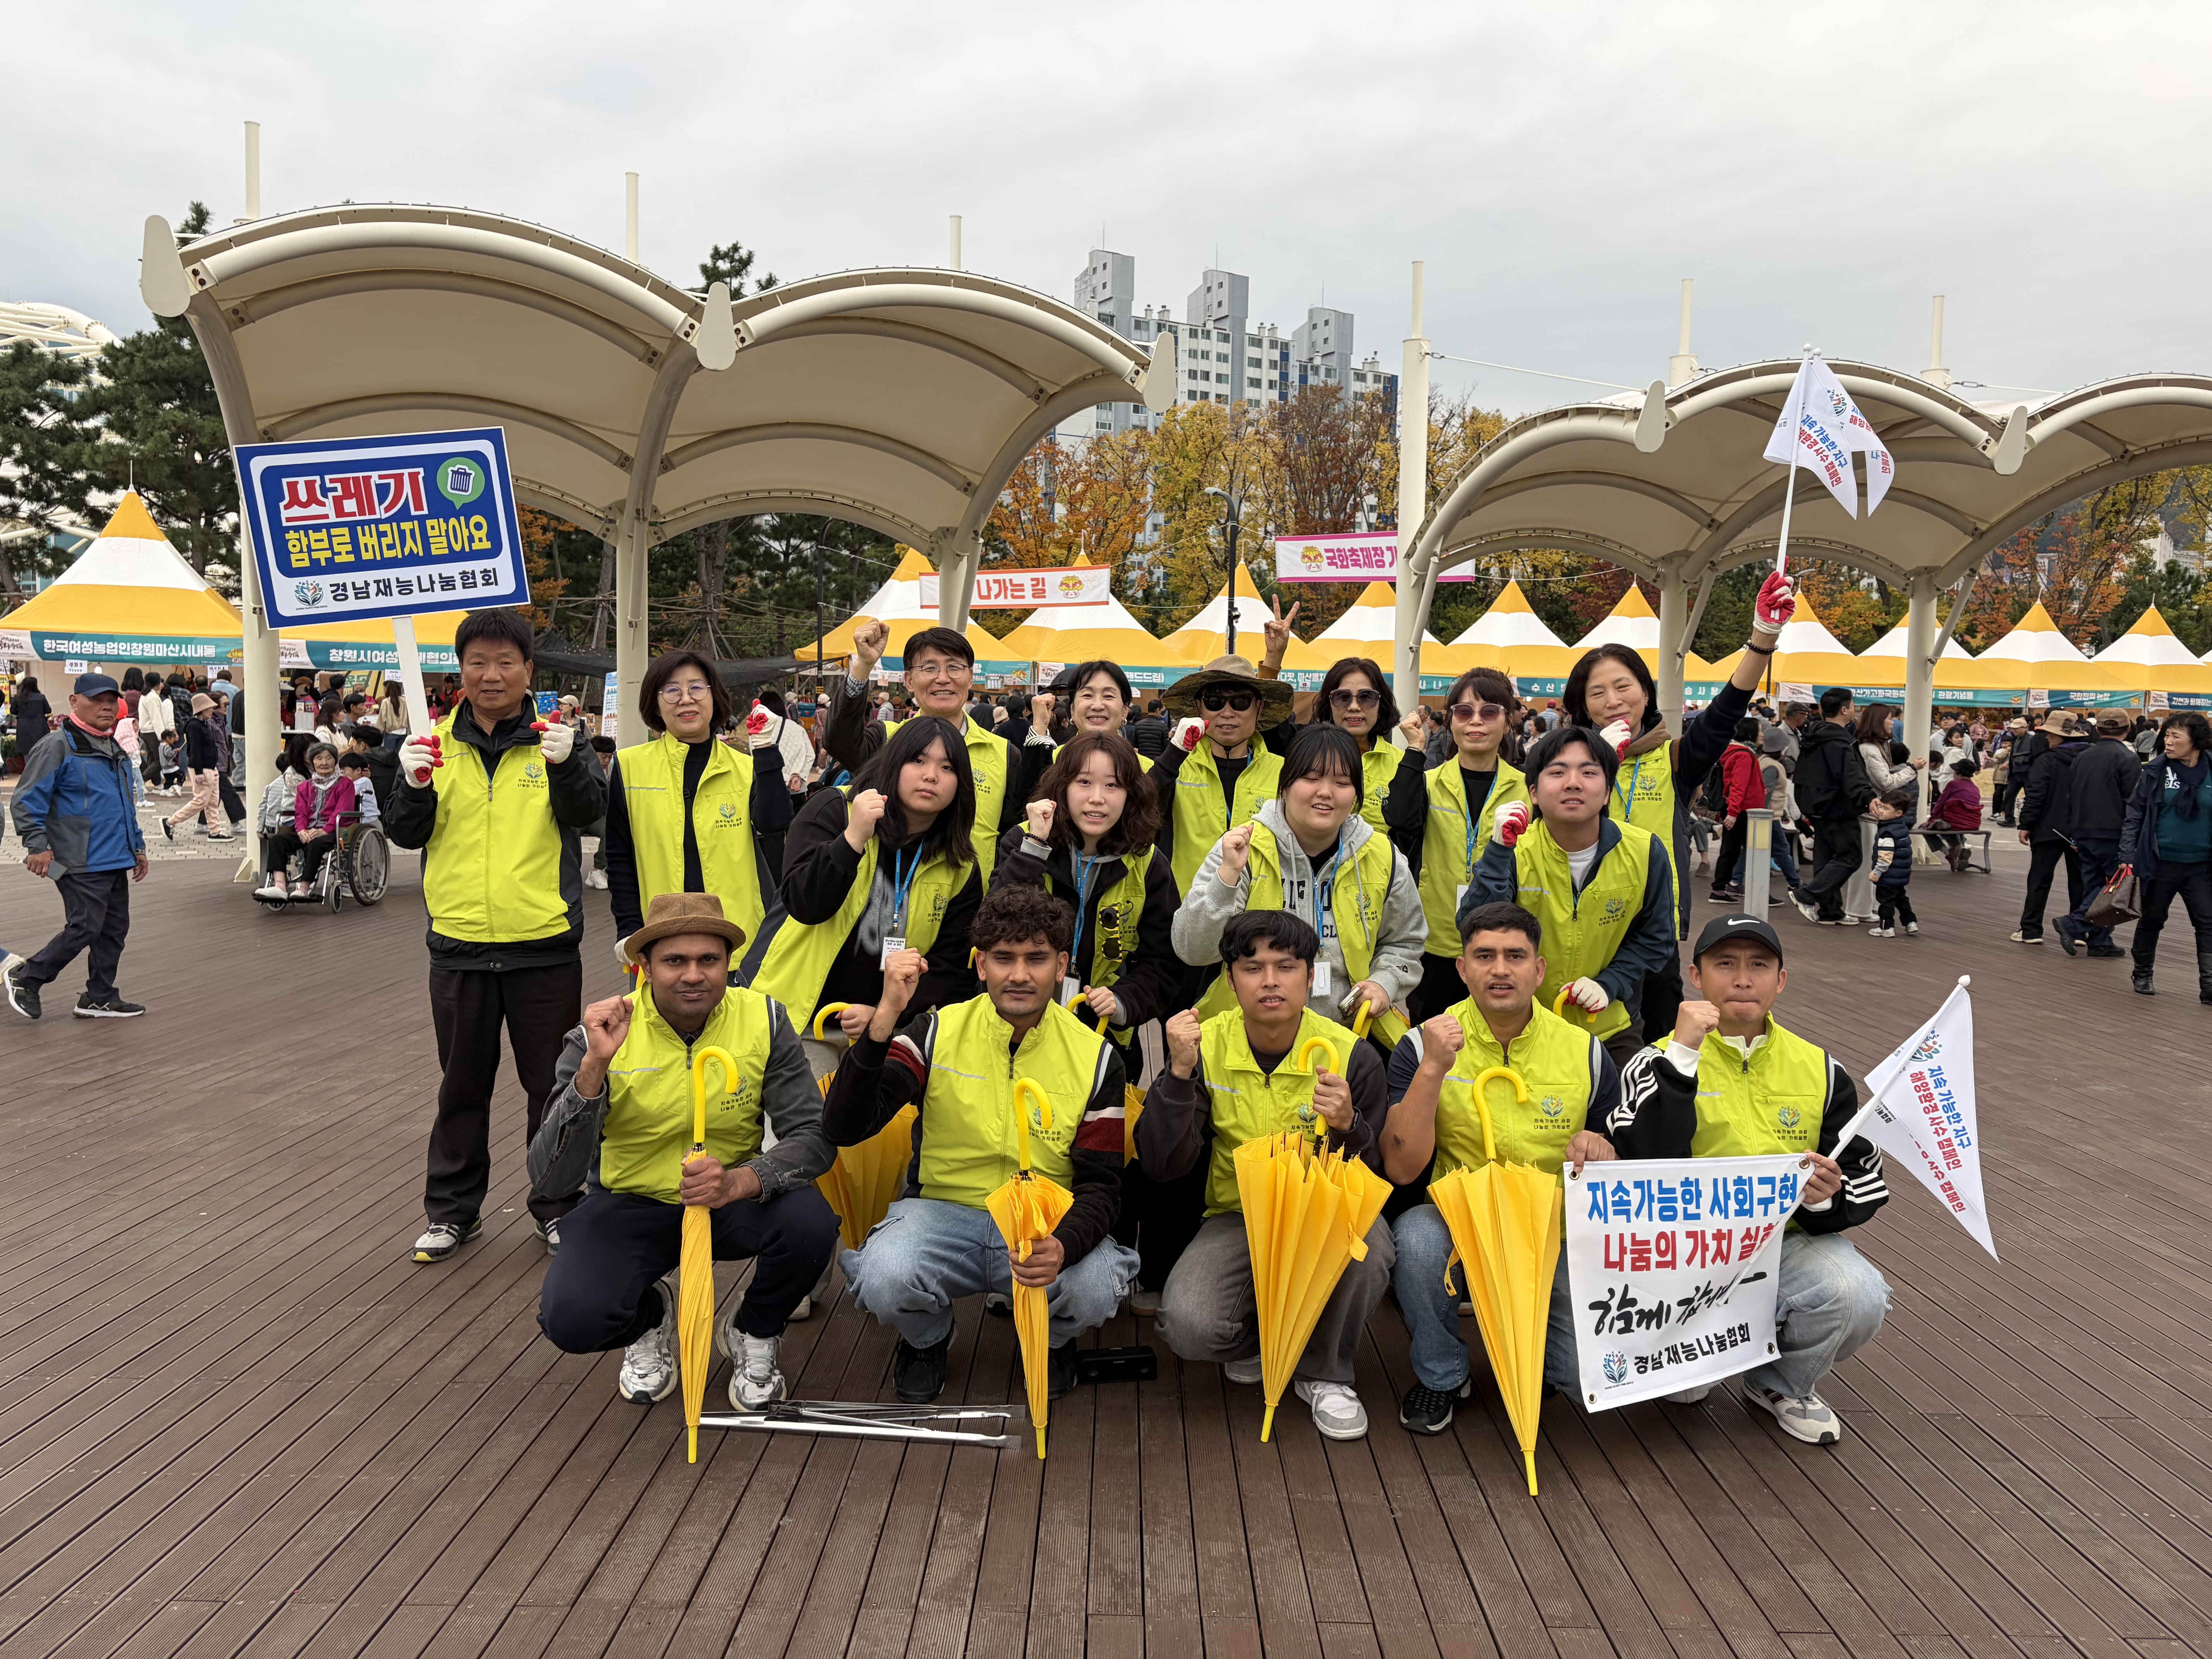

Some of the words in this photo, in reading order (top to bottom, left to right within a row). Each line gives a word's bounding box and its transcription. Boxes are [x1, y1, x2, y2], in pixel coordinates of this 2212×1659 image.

[1801, 414, 1817, 430] 지속
[1814, 426, 1838, 451] 가능한
[1832, 450, 1847, 468] 지구
[1813, 447, 1829, 463] 사수
[1824, 460, 1843, 488] 캠페인
[281, 468, 428, 526] 쓰레기
[285, 527, 355, 568] 함부로
[357, 520, 424, 560] 버리지
[426, 515, 491, 556] 말아요
[1324, 547, 1386, 569] 국화축제장
[329, 567, 499, 602] 경남재능나눔협회
[976, 579, 1025, 600] 나가는
[1030, 577, 1046, 599] 길
[1909, 1070, 1939, 1115] 해양환경
[1927, 1065, 1944, 1089] 지속
[1937, 1089, 1963, 1125] 가능한
[1952, 1126, 1972, 1150] 지구
[1927, 1113, 1948, 1138] 사수
[1937, 1137, 1963, 1171] 캠페인
[1587, 1177, 1703, 1224] 지속가능한
[1709, 1173, 1798, 1219] 사회구현
[1928, 1161, 1945, 1181] 사수
[1939, 1180, 1966, 1214] 캠페인
[1604, 1231, 1677, 1272] 나눔의
[1685, 1228, 1733, 1269] 가치
[1589, 1284, 1671, 1336] 함께
[1634, 1322, 1751, 1375] 경남재능나눔협회
